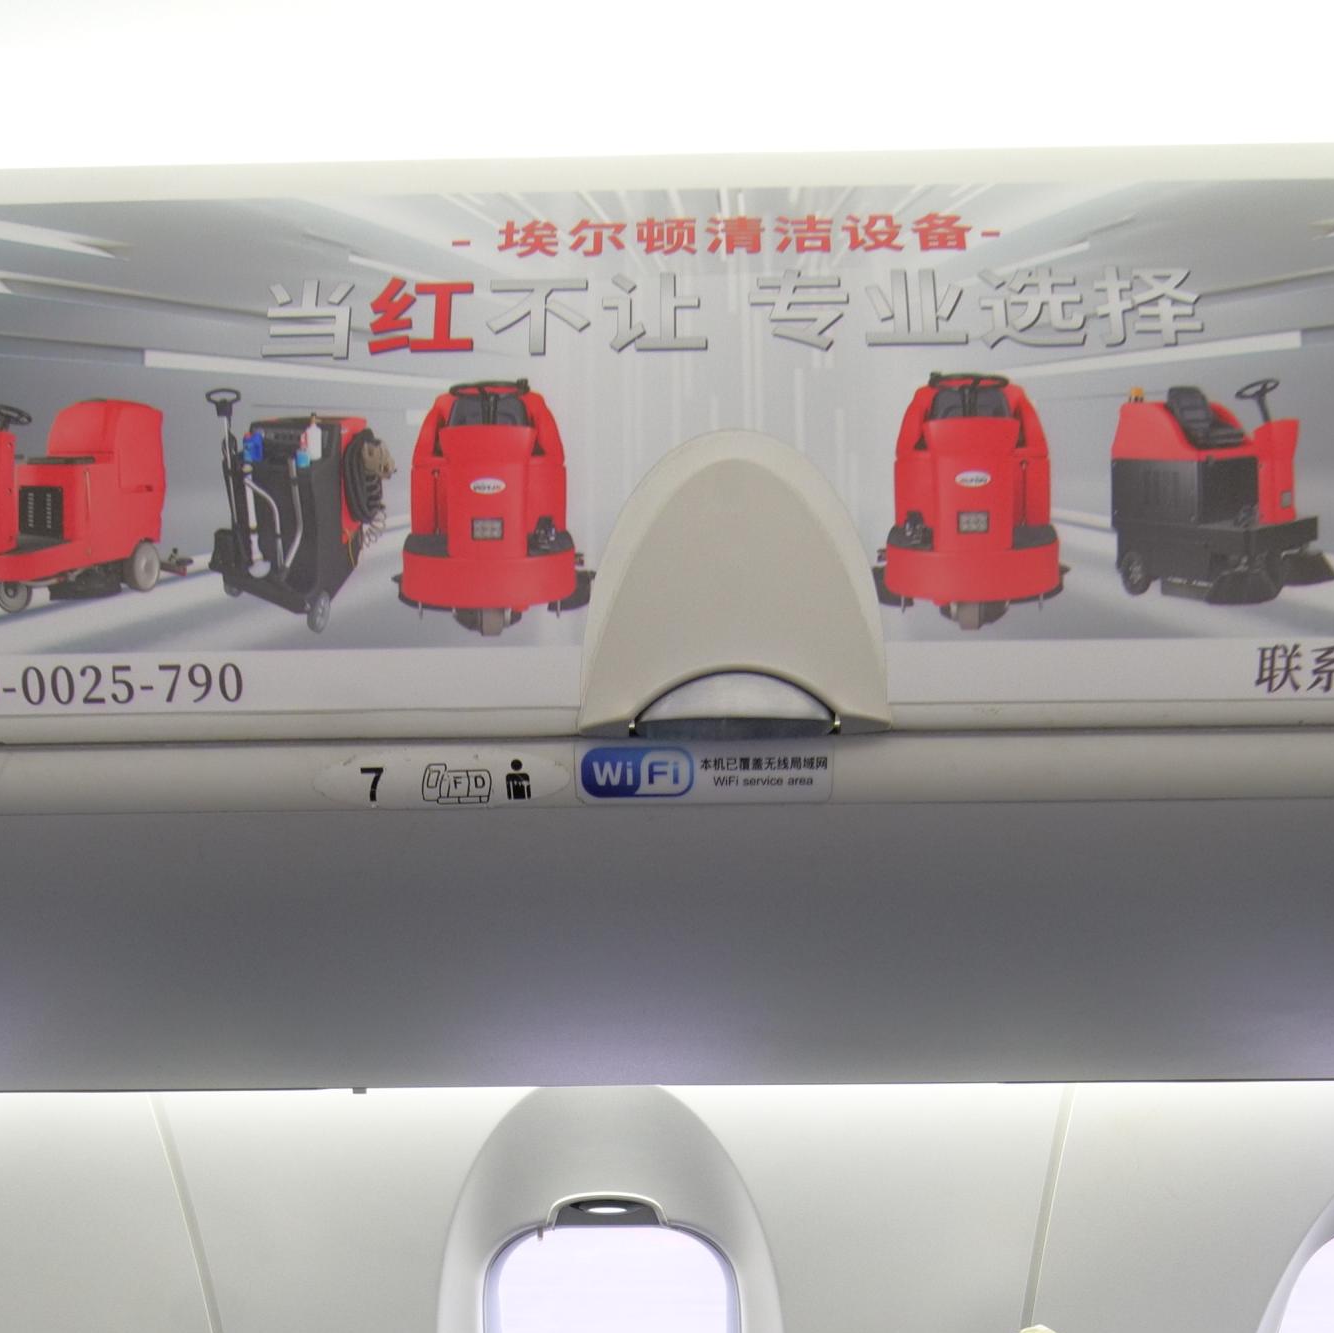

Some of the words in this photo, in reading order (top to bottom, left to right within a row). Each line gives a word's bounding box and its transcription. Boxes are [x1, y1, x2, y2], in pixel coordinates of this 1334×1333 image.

[261, 270, 709, 358] 当红不让
[748, 264, 1206, 350] 专业选择
[699, 756, 829, 772] 本机已覆盖无线局域网
[360, 767, 384, 802] 7
[713, 775, 739, 788] WiFi
[743, 776, 784, 788] service
[787, 778, 814, 788] area
